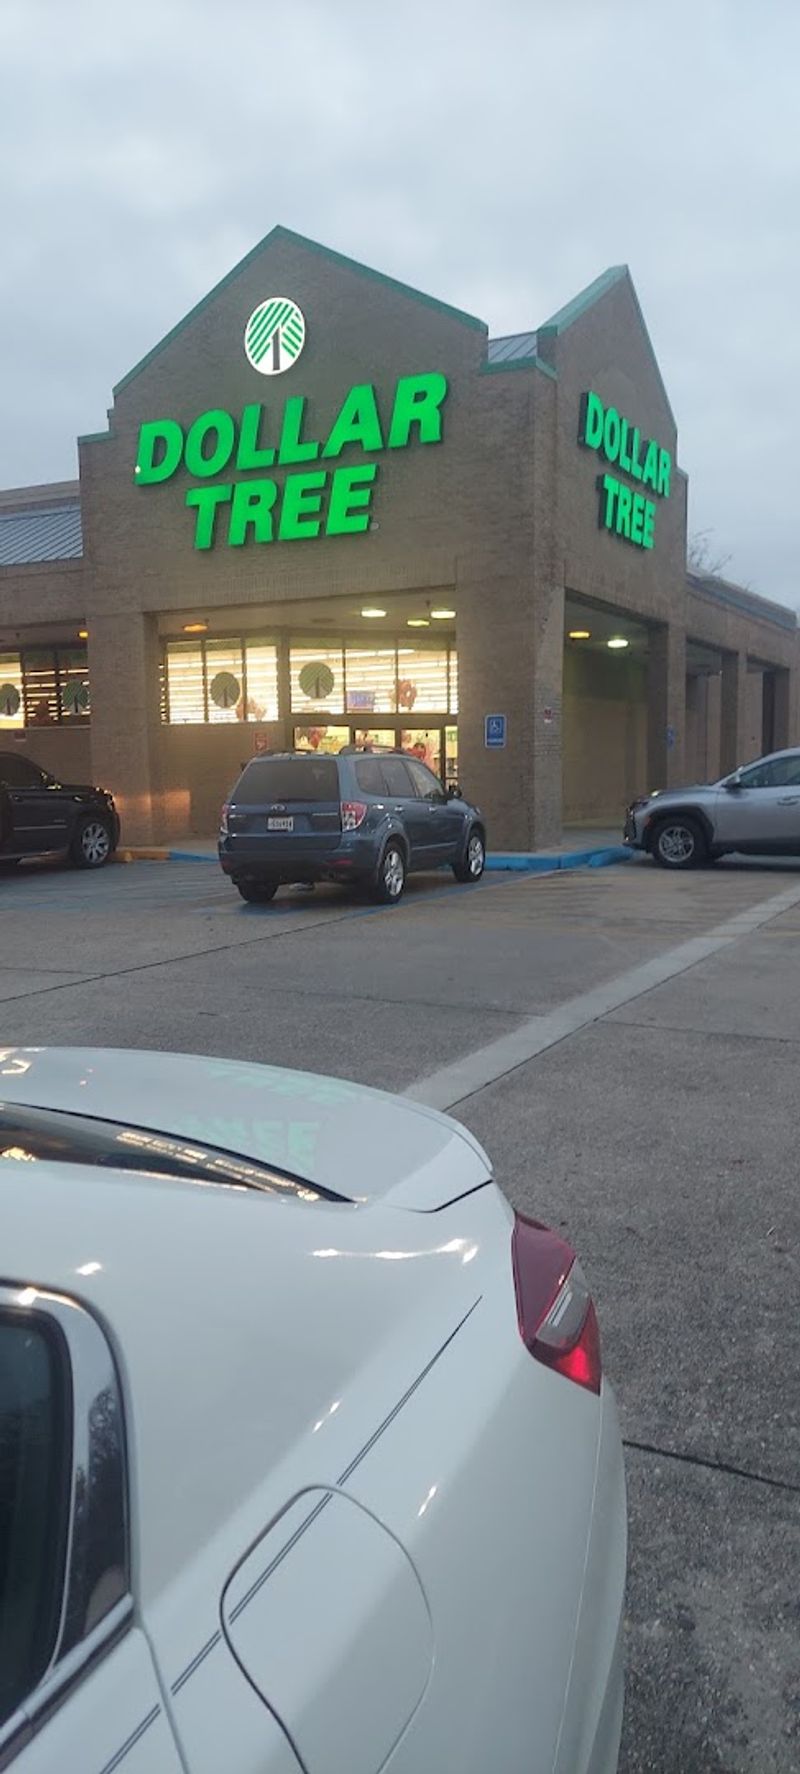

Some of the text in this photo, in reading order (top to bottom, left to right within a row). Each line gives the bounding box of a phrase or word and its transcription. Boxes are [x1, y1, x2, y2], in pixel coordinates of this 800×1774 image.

[134, 372, 447, 485] DOLLAR
[584, 391, 671, 497] DOLLAR
[186, 464, 377, 549] TREE
[603, 473, 656, 549] TREE
